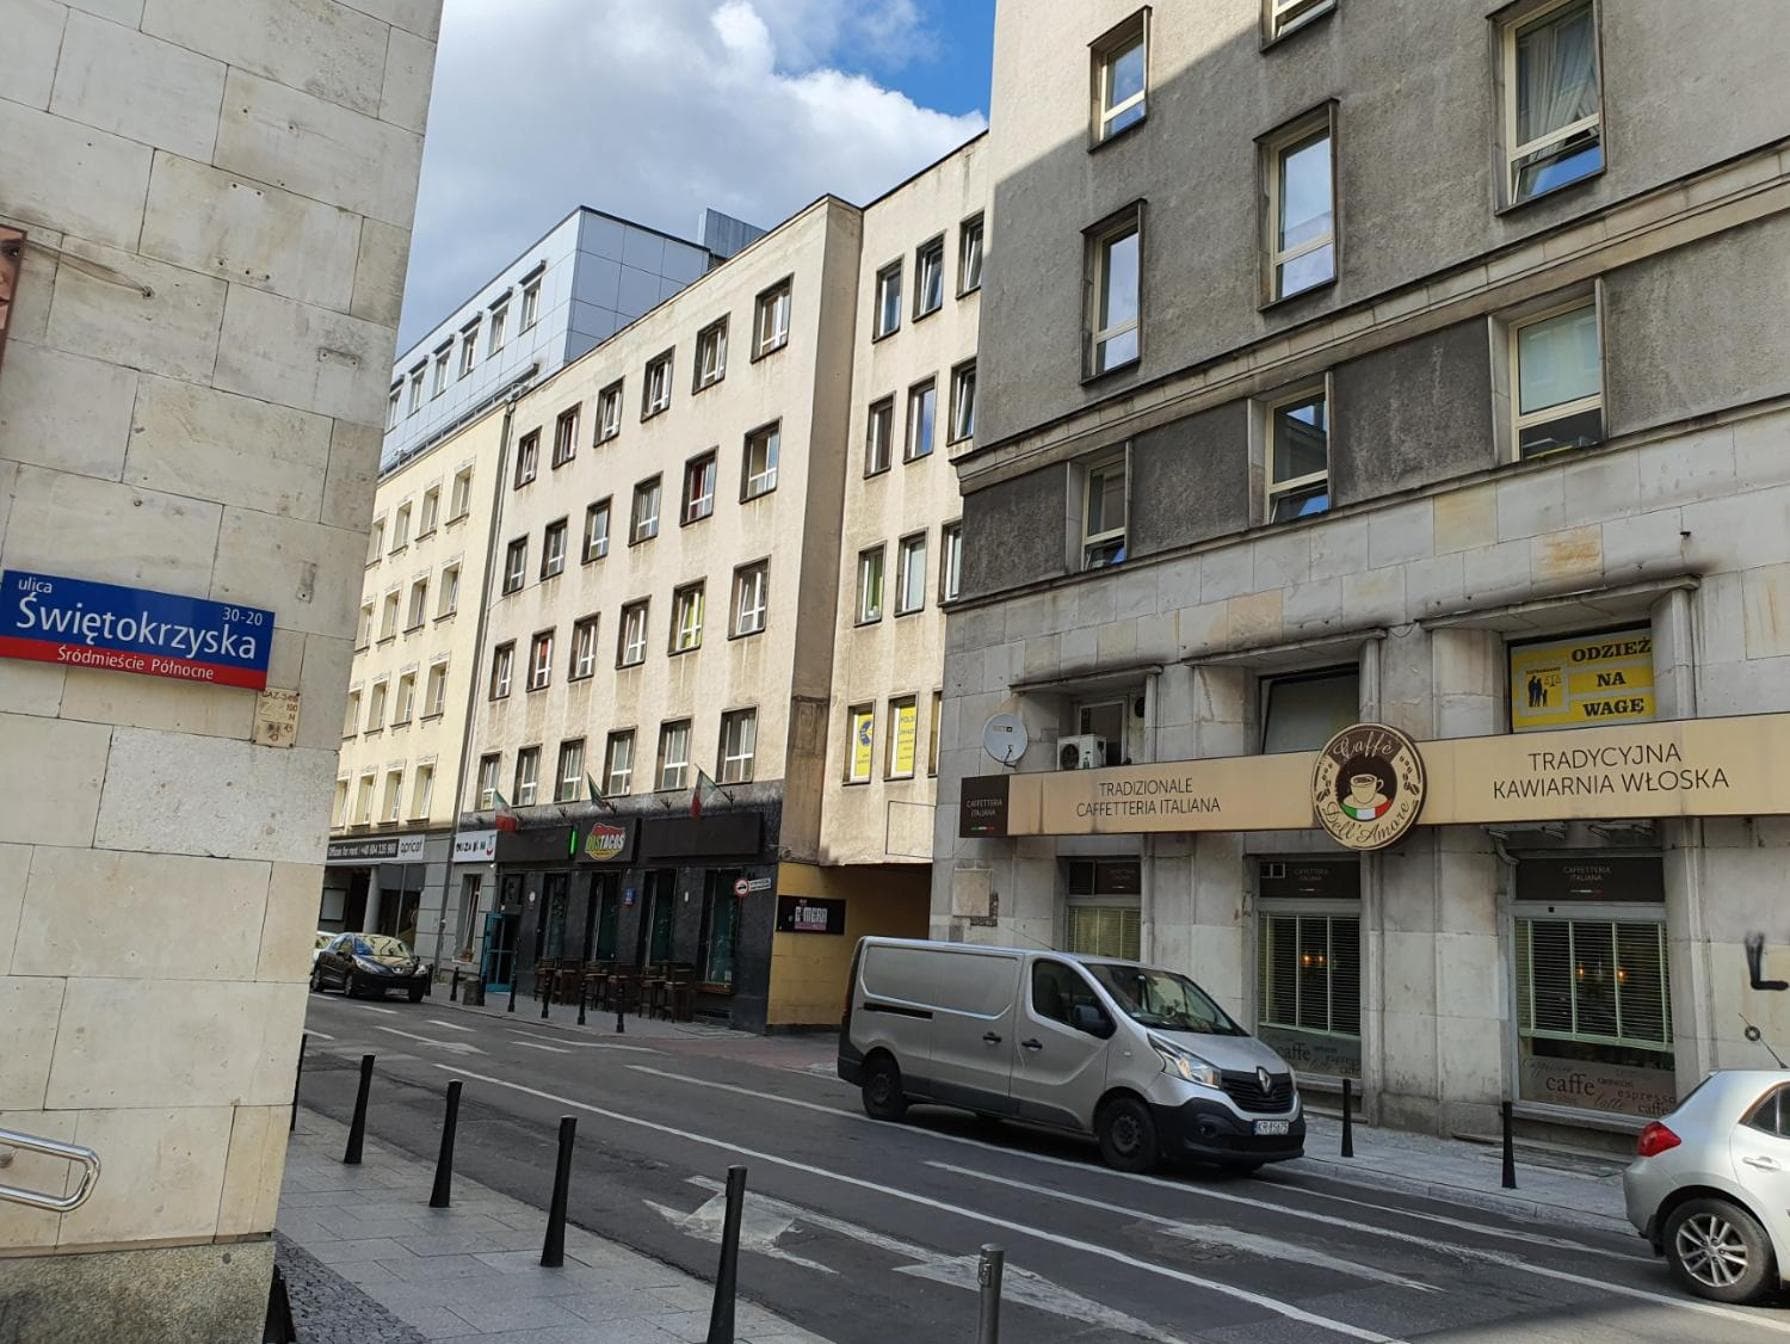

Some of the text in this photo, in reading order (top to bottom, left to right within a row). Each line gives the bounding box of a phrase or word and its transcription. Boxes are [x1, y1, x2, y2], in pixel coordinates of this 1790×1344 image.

[18, 577, 53, 593] ulica
[16, 592, 256, 660] Świętokrzyska
[222, 607, 263, 626] 30-20
[1572, 637, 1651, 663] ODZIEŻ
[57, 644, 214, 680] Śródmieście Północne
[1597, 672, 1625, 688] NA
[1583, 698, 1644, 718] WAGĘ
[1529, 743, 1681, 771] TRADYCYJNA
[1100, 778, 1193, 796] TRADIZIONALE
[1494, 768, 1729, 799] KAWIARNIA WŁOSKA
[1076, 798, 1221, 818] CAFFETTERIA ITALIANA
[1546, 1073, 1595, 1097] caffe
[1617, 1090, 1676, 1105] espresso
